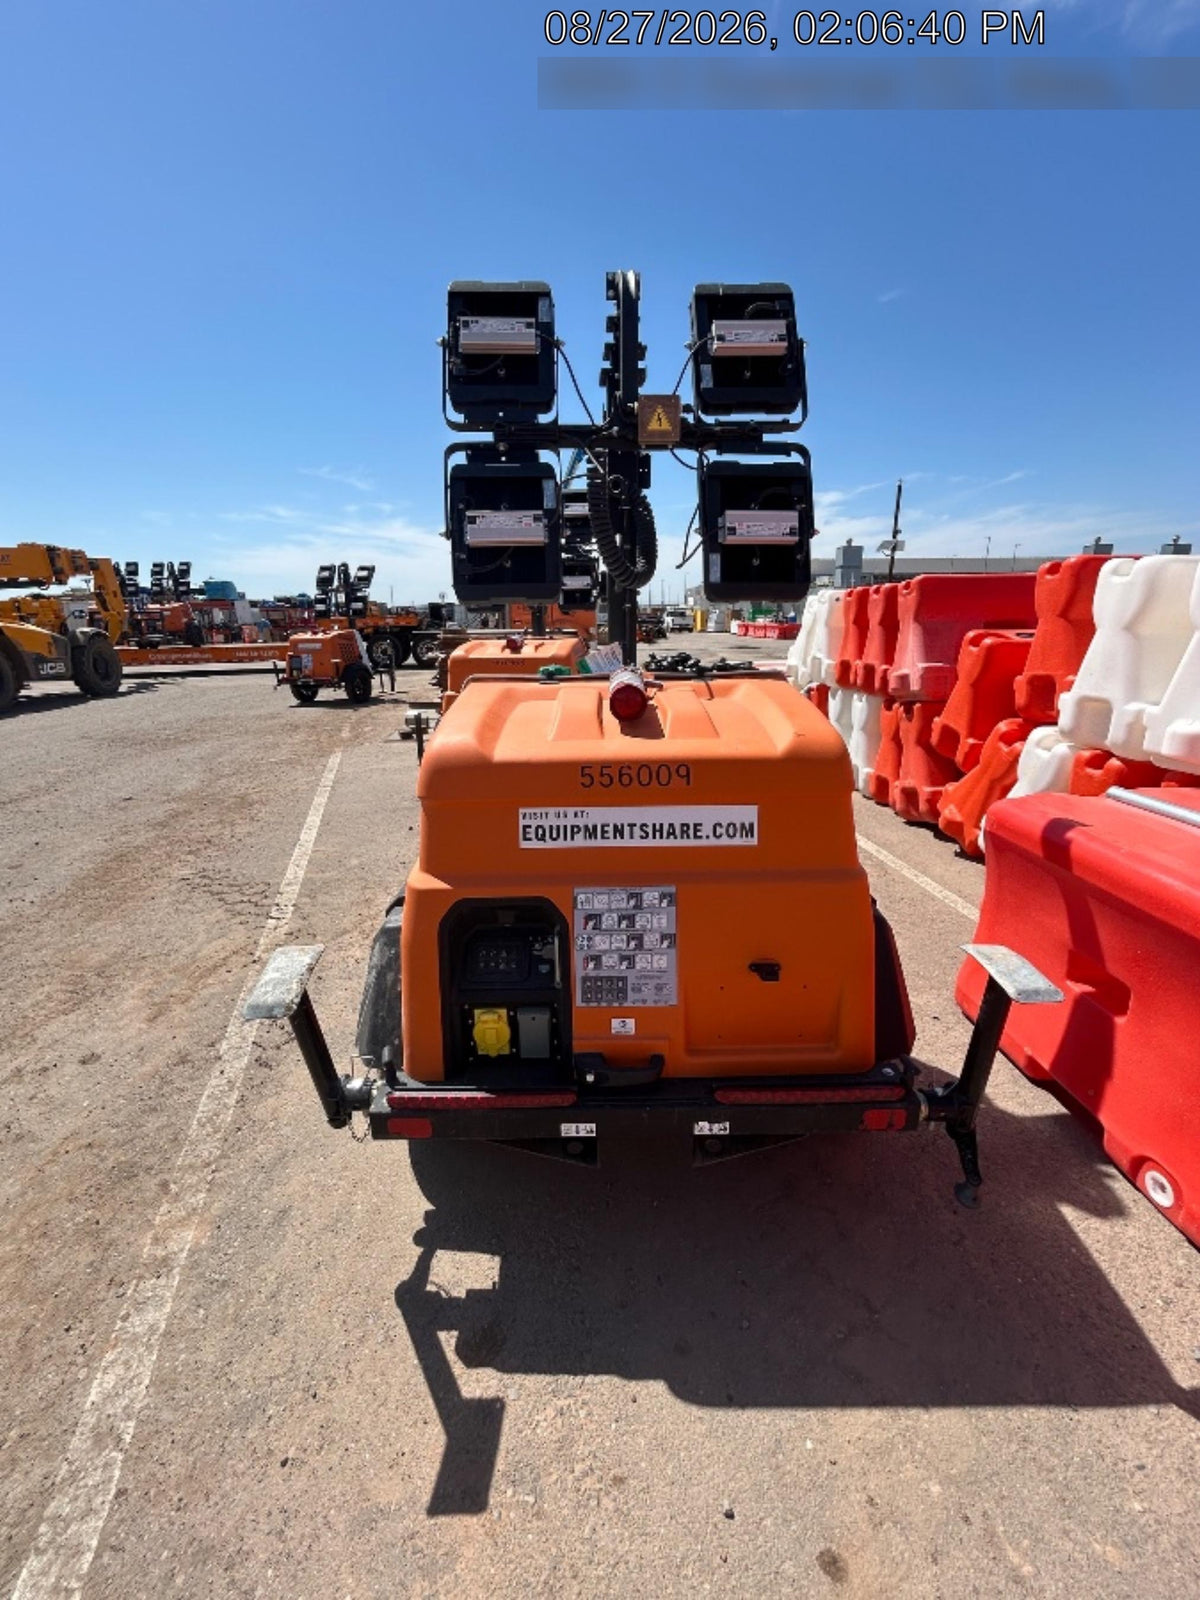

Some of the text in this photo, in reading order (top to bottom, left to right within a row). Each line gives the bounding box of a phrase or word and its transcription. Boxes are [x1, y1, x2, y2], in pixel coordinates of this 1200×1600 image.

[40, 662, 66, 675] JCB
[579, 763, 691, 788] 556009
[521, 812, 549, 820] VISIT
[554, 810, 568, 819] US
[521, 821, 755, 843] EQUIPMENTSHARE.COM
